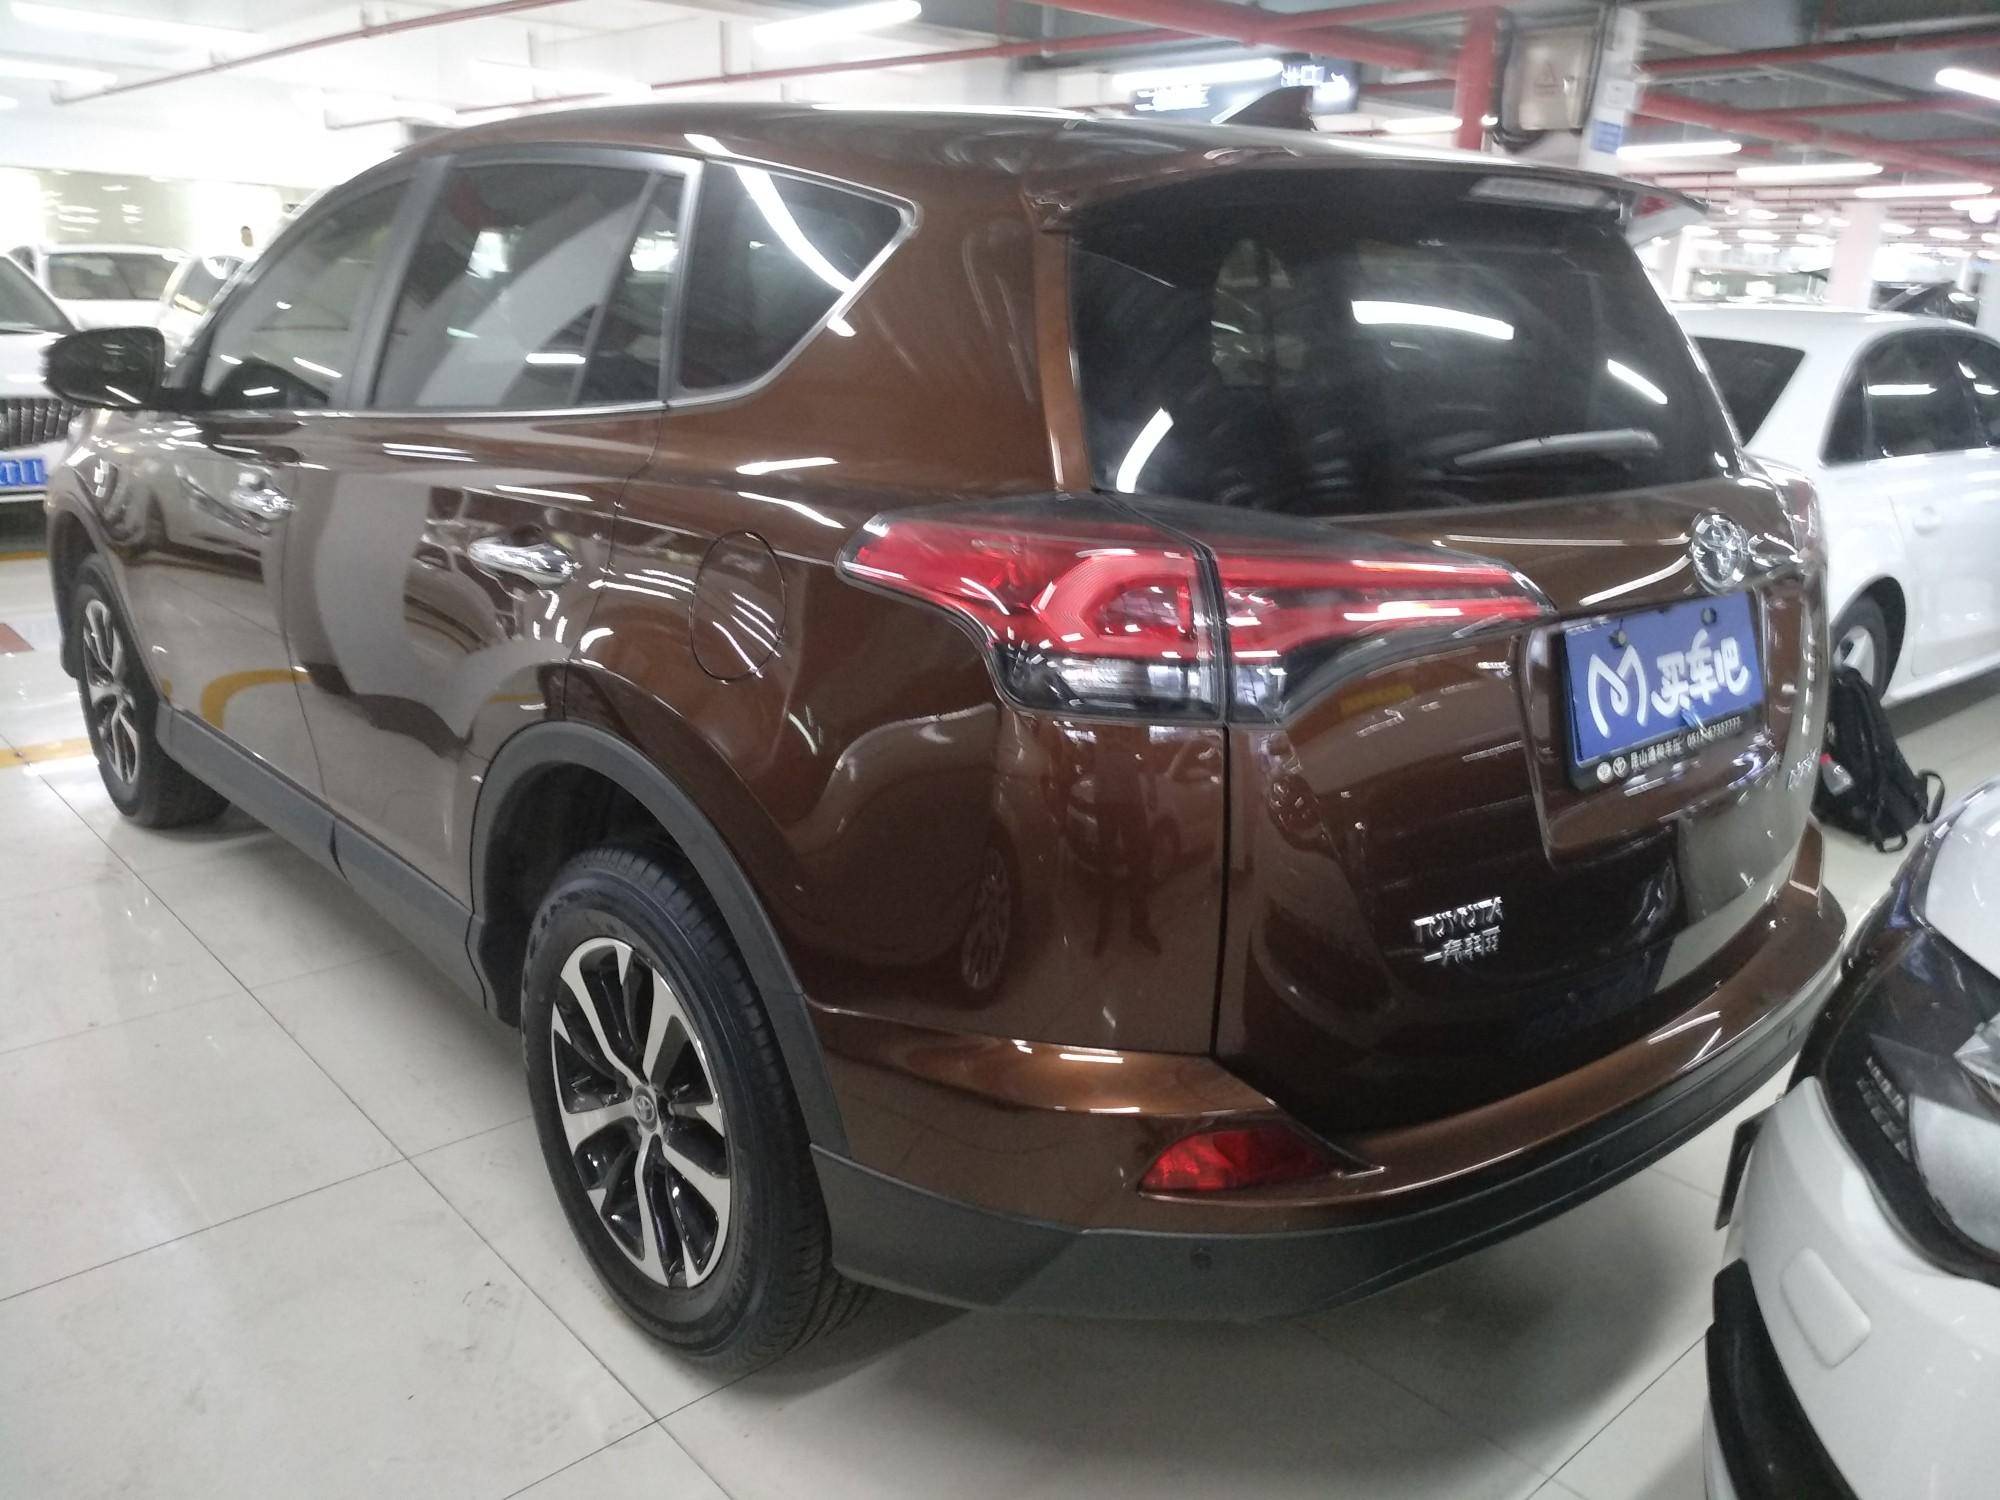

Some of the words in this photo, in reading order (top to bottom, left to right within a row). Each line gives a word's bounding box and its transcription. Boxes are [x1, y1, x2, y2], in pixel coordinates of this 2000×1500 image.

[1650, 628, 1750, 718] 买车吧
[1414, 896, 1504, 942] TOYOTA
